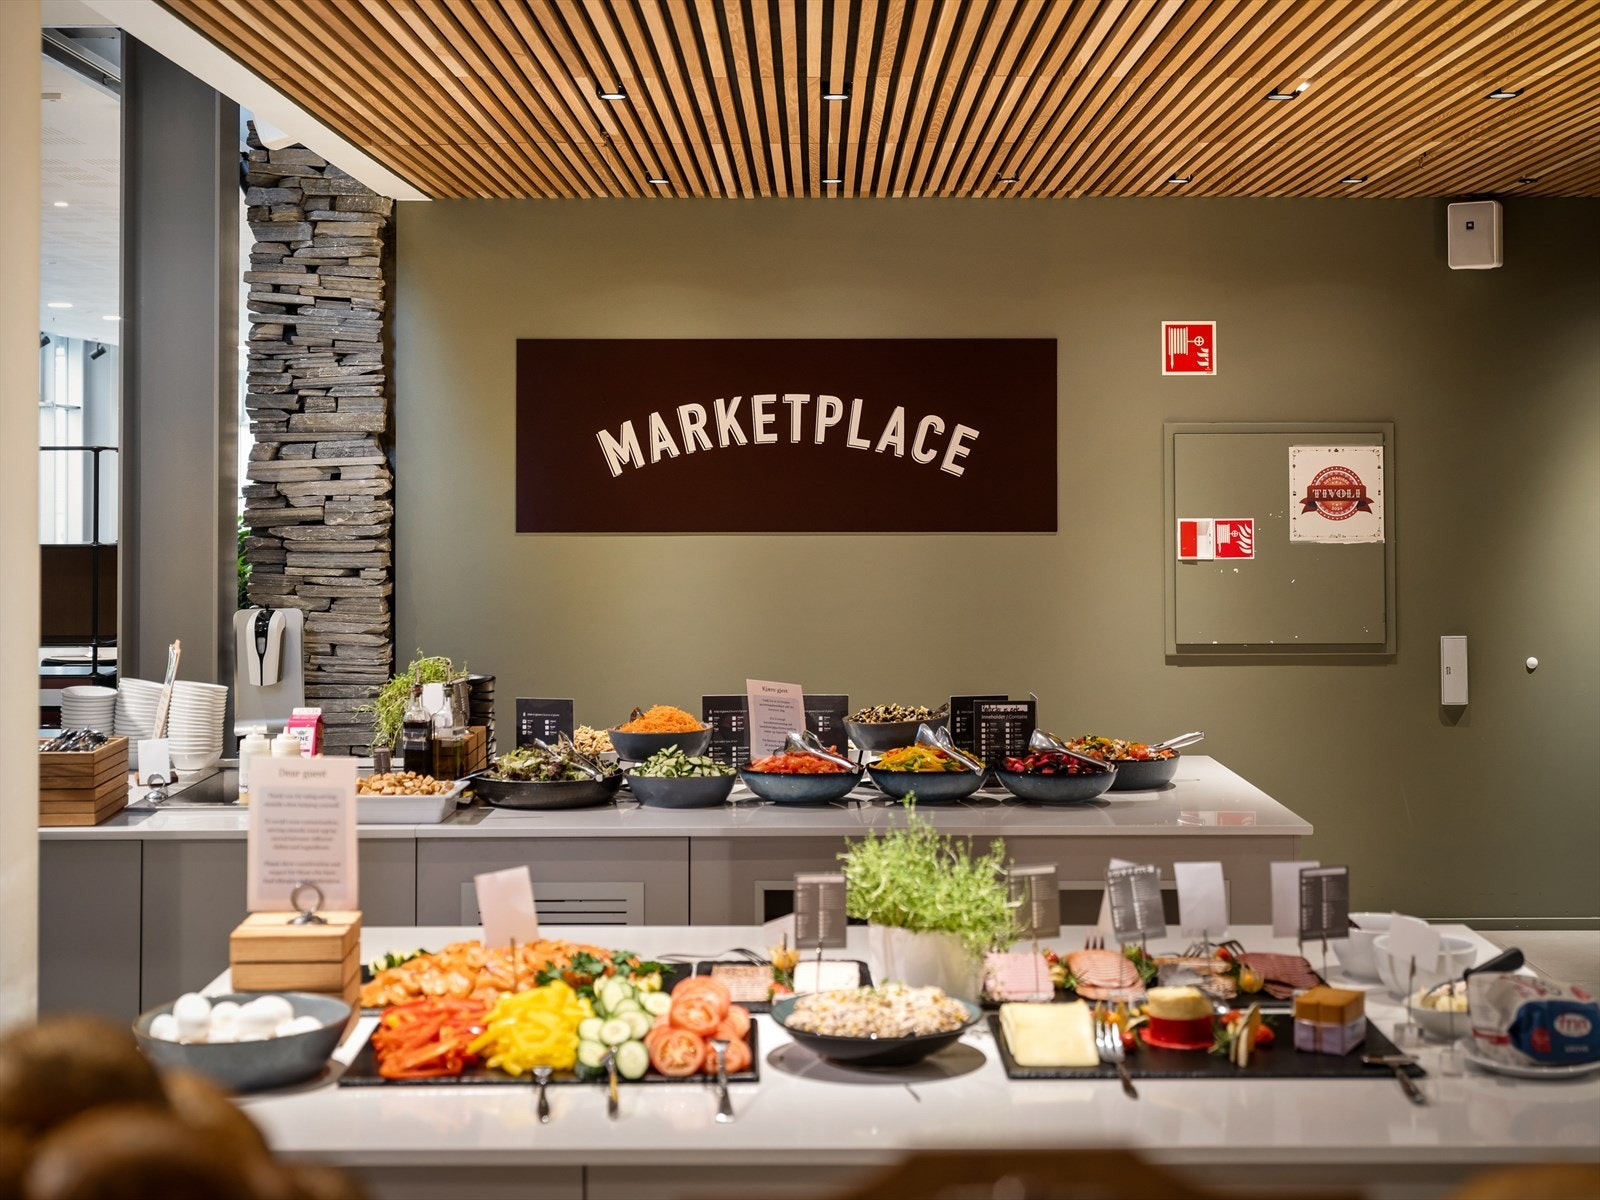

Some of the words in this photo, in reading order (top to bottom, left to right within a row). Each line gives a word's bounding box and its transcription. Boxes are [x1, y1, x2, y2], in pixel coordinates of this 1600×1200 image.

[596, 393, 980, 478] MARKETPLACE
[1312, 488, 1361, 499] TIVOLI
[278, 768, 300, 778] Dear
[302, 769, 327, 779] guest
